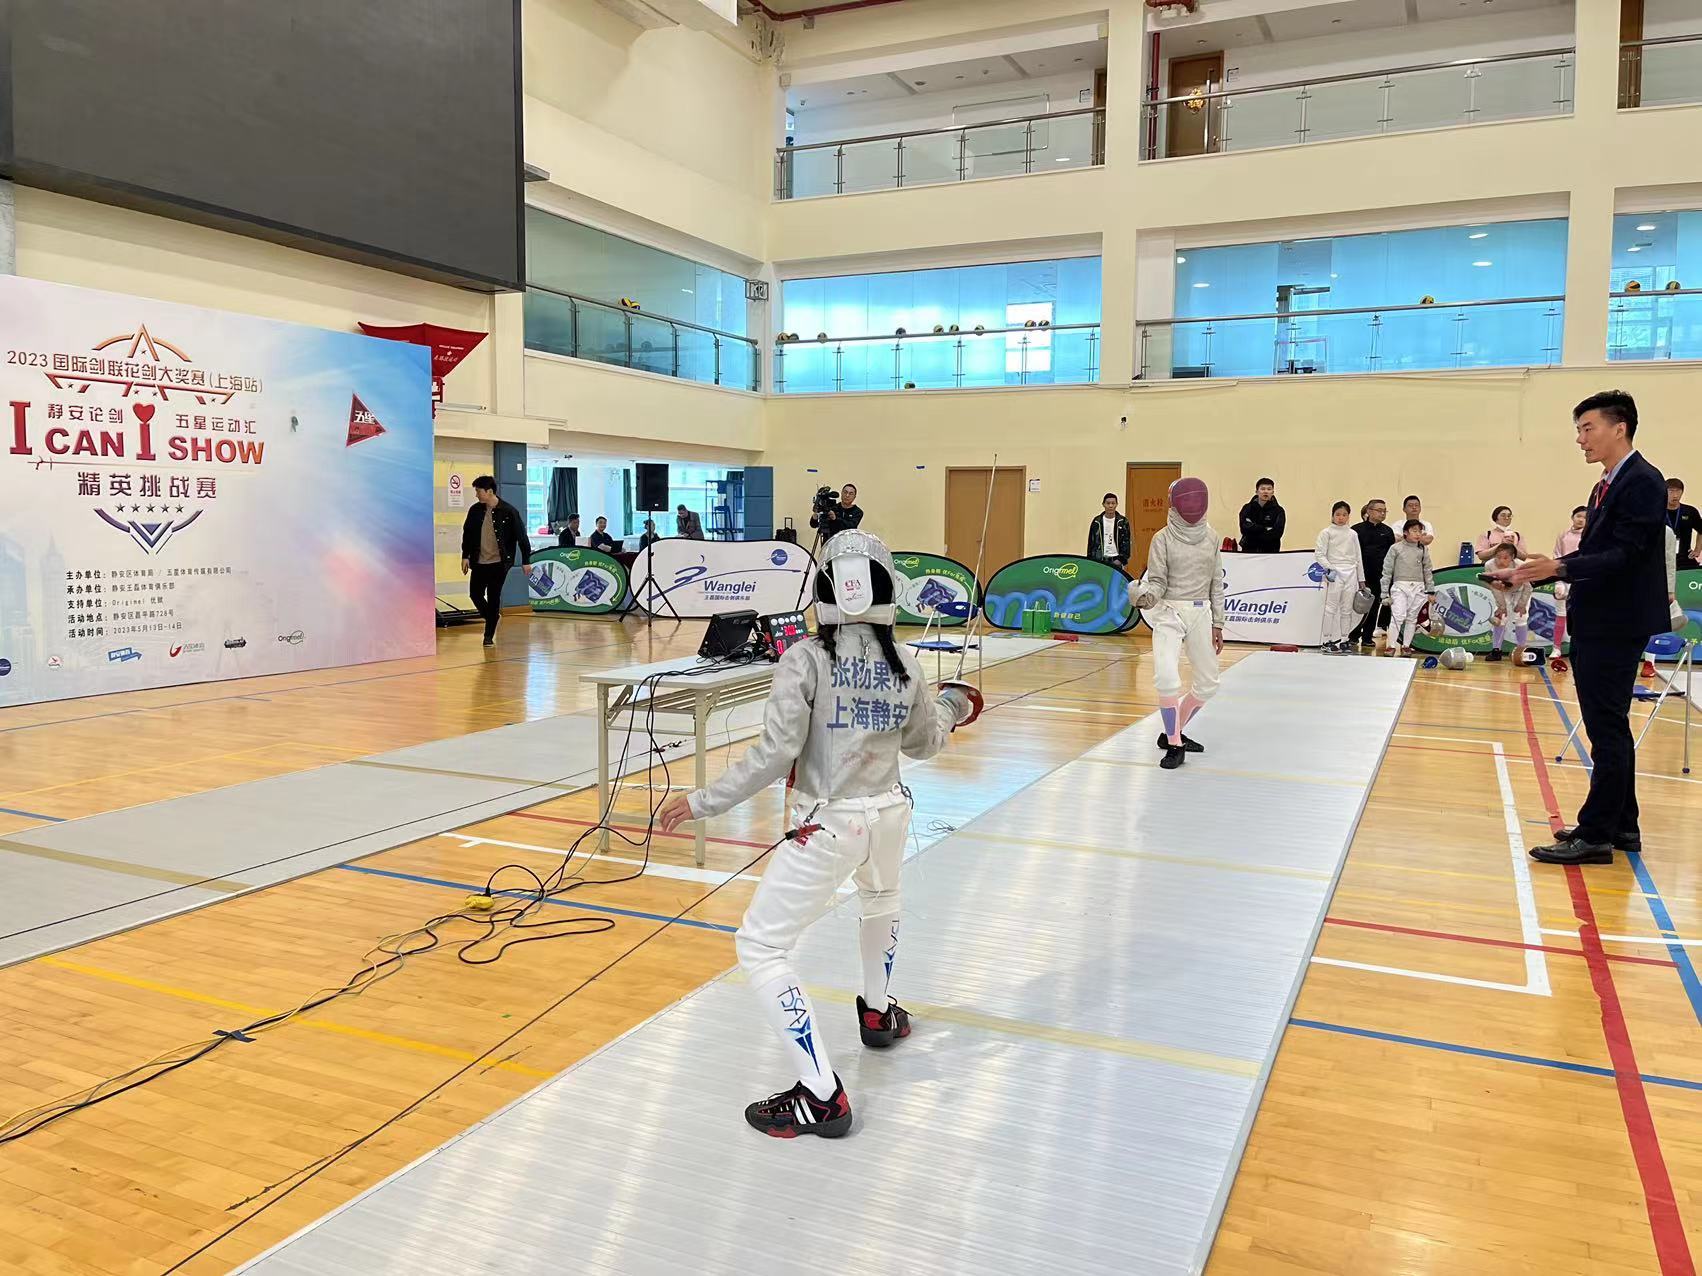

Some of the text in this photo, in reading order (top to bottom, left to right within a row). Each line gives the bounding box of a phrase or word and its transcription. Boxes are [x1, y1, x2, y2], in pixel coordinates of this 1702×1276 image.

[9, 401, 264, 464] I CAN I SHOW
[48, 403, 256, 435] 静安论剑 五星运动汇
[78, 471, 216, 498] 精英挑战赛
[704, 580, 757, 594] Wanglei
[1224, 599, 1288, 615] Wanglei
[827, 696, 909, 731] 上海静安
